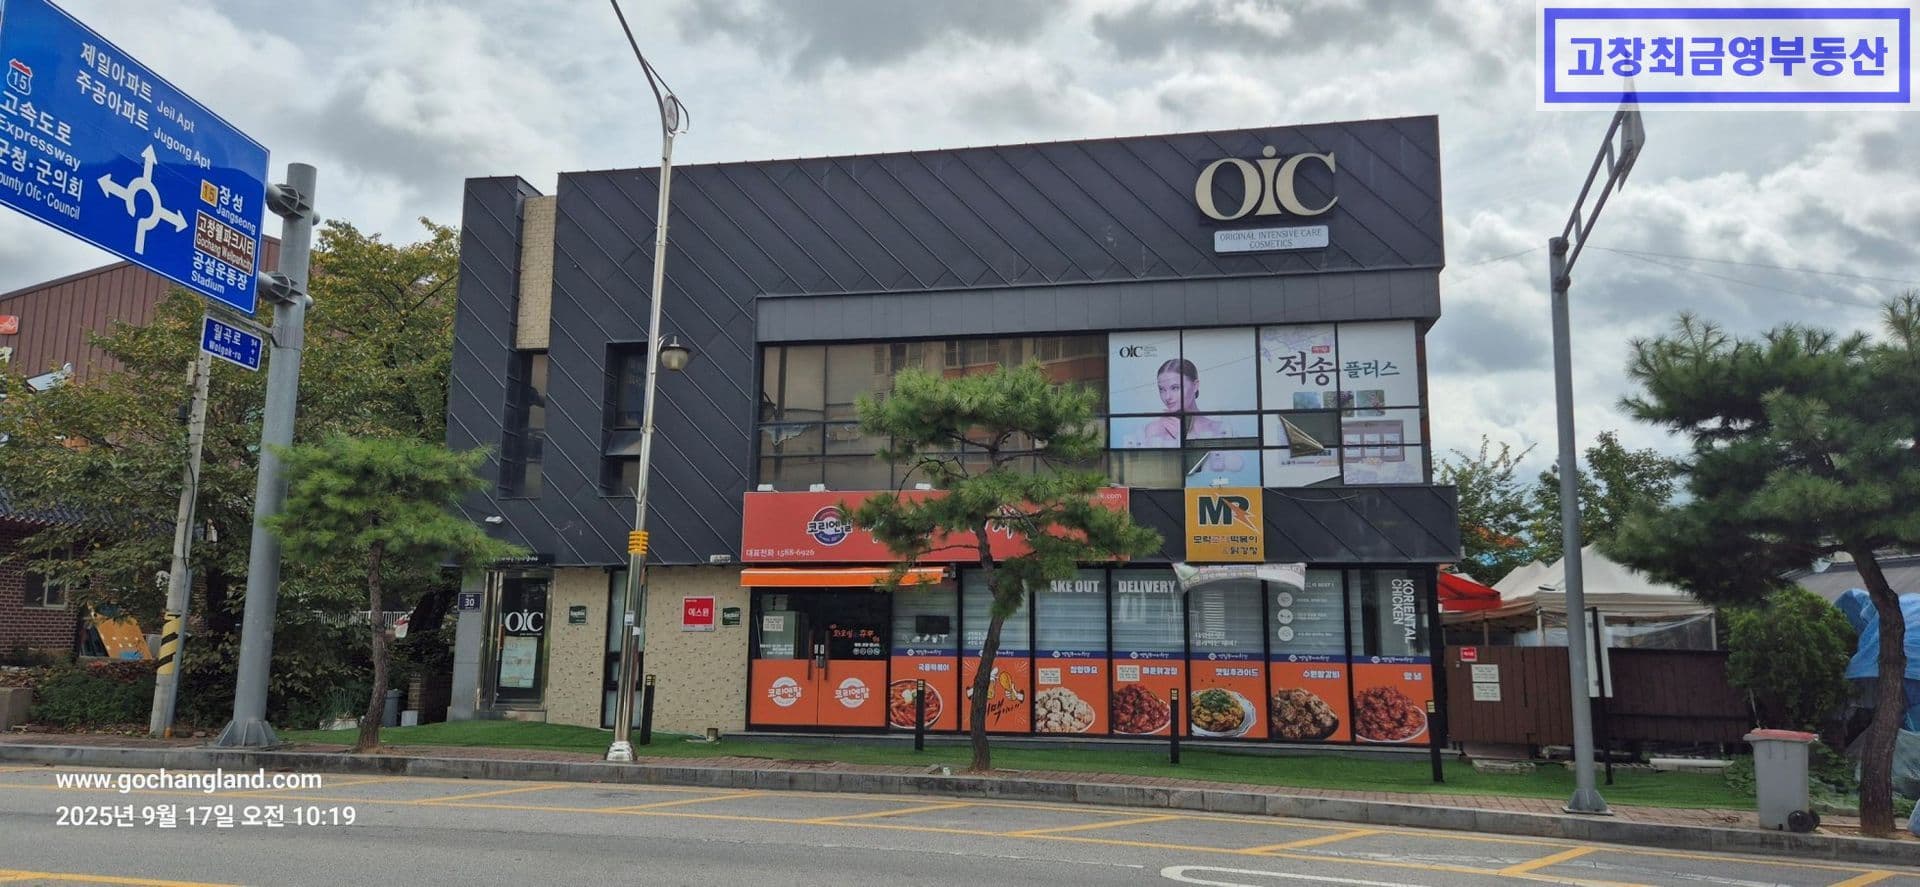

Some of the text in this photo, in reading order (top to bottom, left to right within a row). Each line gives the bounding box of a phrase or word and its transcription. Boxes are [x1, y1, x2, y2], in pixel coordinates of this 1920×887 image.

[13, 71, 27, 90] 15
[80, 42, 152, 103] 제일아파트
[76, 69, 149, 131] 주공아파트
[0, 90, 72, 146] 고속도로
[157, 101, 196, 133] Jeil Apt
[0, 115, 81, 172] Expressway
[154, 127, 211, 170] Jugong Apt
[0, 172, 24, 196] ounty
[219, 185, 244, 213] 장성
[216, 203, 256, 236] Jangseong
[1220, 231, 1256, 241] ORIGINAL
[1258, 228, 1300, 240] INTENSIVE
[1249, 239, 1293, 249] COSMETICS
[191, 270, 225, 294] Stadium
[193, 250, 248, 291] 공설운동장
[213, 323, 241, 346] 월곡로
[1276, 351, 1400, 386] 적송 플러스
[1049, 580, 1100, 593] AKE OUT
[1118, 580, 1176, 593] DELIVERY
[464, 598, 475, 607] 30
[687, 607, 709, 617] 에스원
[1391, 579, 1404, 625] CHICKEN
[1402, 579, 1417, 644] KORIENTAL
[767, 686, 802, 698] 코리엔탈
[834, 686, 870, 699] 코리엔탈
